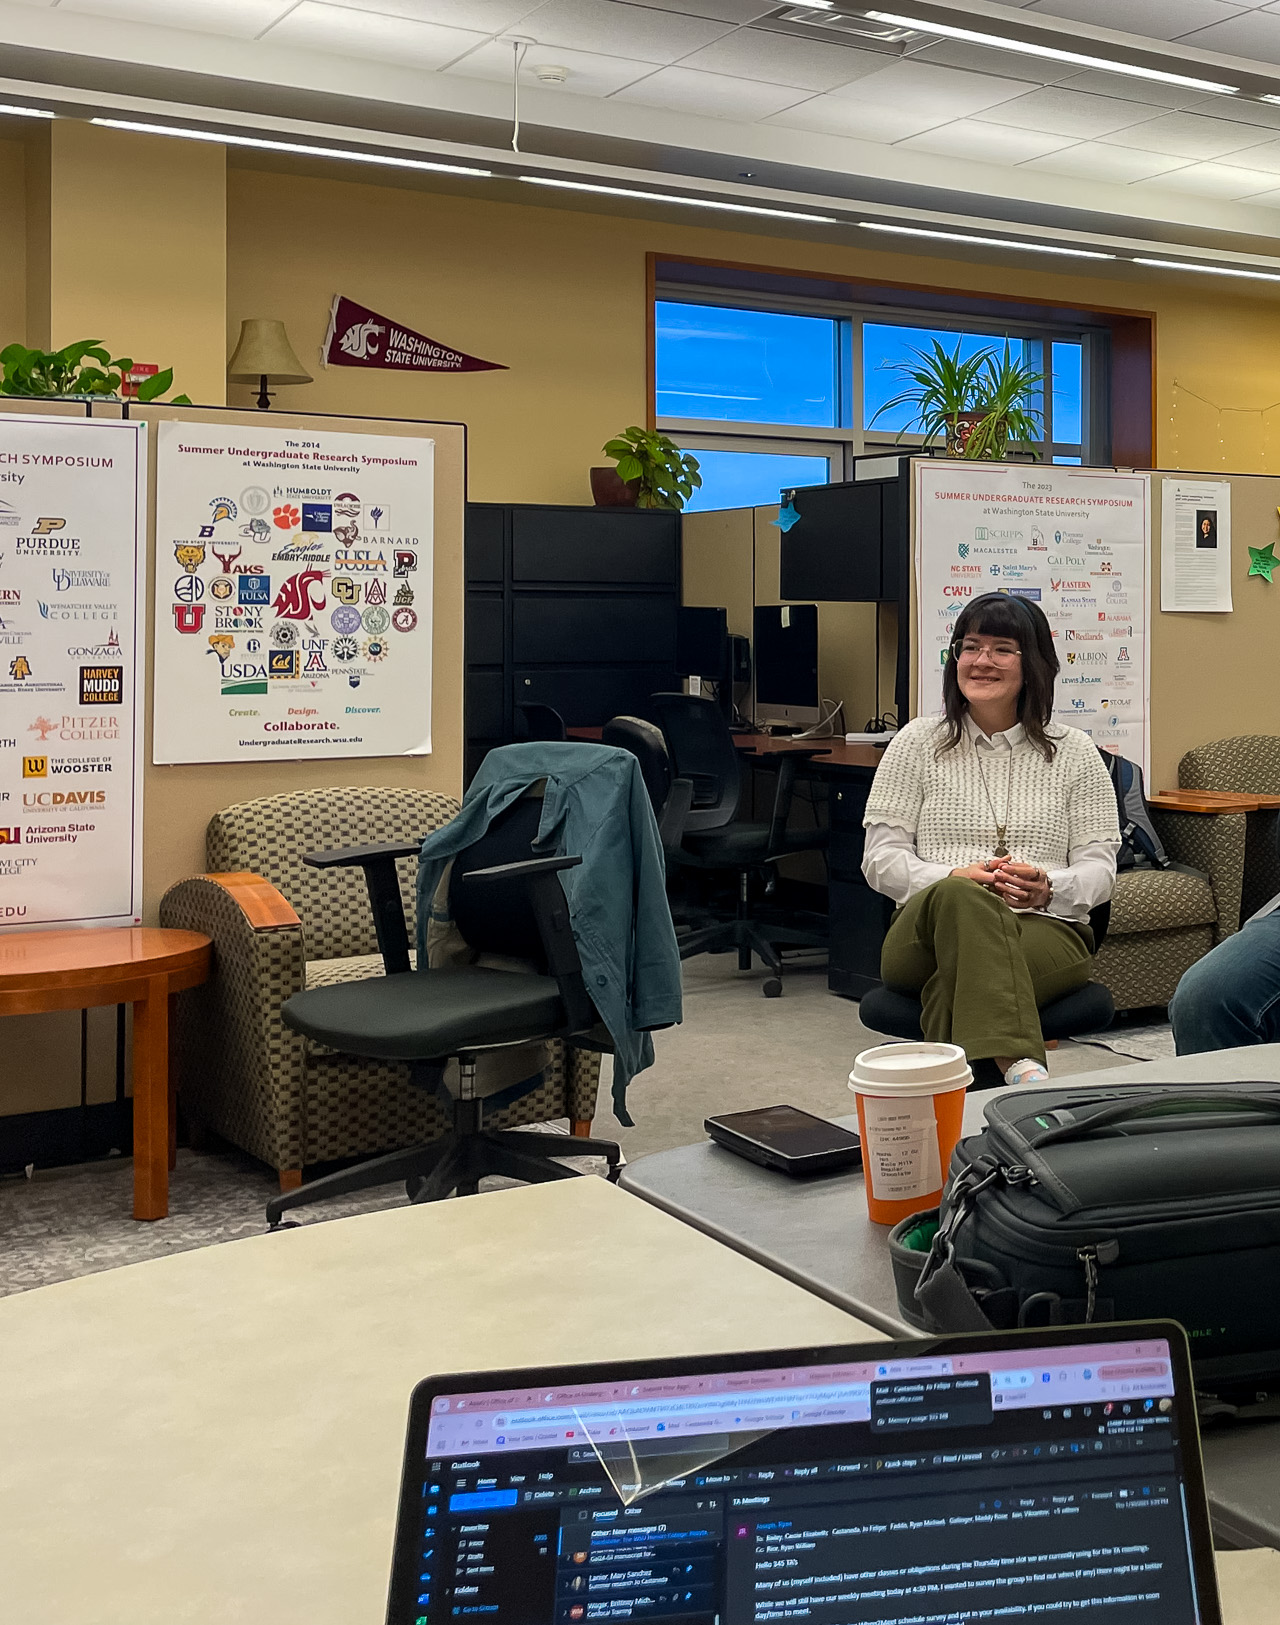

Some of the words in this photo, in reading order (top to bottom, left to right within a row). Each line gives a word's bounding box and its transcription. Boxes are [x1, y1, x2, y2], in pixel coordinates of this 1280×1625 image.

[389, 327, 463, 363] WASHINGTON
[384, 348, 411, 365] STATE
[412, 356, 462, 369] UNIVERSITY
[301, 441, 320, 449] 2014
[22, 454, 113, 468] SYMPOSIUM
[178, 444, 224, 455] Summer
[227, 447, 309, 460] Undergraduate
[312, 452, 358, 463] Research
[361, 455, 418, 467] Symposium
[253, 461, 299, 470] Washington
[301, 463, 321, 471] State
[323, 464, 360, 474] University
[286, 487, 332, 496] HUMBOLDT
[1022, 481, 1036, 489] The
[1037, 484, 1053, 492] 2023
[935, 491, 971, 500] SUMMER
[972, 494, 1044, 504] UNDERGRADUATE
[1045, 497, 1086, 506] RESEARCH
[1087, 499, 1133, 507] SYMPOSIUM
[992, 507, 1034, 517] Washington
[1035, 509, 1054, 517] State
[1055, 510, 1090, 519] University
[16, 537, 80, 549] PURDUE
[362, 536, 419, 545] BARNARD
[271, 552, 331, 563] EMBRY-RIDDLE
[334, 549, 389, 572] SUSLA
[1062, 581, 1091, 589] EASTERN
[240, 592, 269, 601] TULSA
[943, 586, 972, 596] CWU
[50, 611, 118, 620] COLLEGE
[215, 606, 264, 617] STONY
[302, 639, 330, 650] UNF
[67, 646, 122, 656] GONZAGA
[83, 667, 119, 678] HARVEY
[221, 663, 268, 678] USDA
[83, 679, 119, 692] MUDD
[83, 692, 119, 702] COLLEGE
[228, 708, 261, 717] Create.
[287, 707, 319, 717] Design.
[344, 706, 381, 714] Discover.
[61, 716, 119, 728] PITZER
[263, 720, 340, 732] Collaborate.
[59, 729, 120, 741] COLLEGE
[51, 764, 113, 774] WOOSTER
[26, 825, 66, 834] Arizona
[67, 823, 96, 832] State
[25, 834, 78, 844] University
[451, 1460, 481, 1471] Outlook
[757, 1471, 775, 1480] Reply
[476, 1478, 498, 1486] Home
[742, 1496, 771, 1505] Meetings
[592, 1508, 619, 1518] Focused
[755, 1561, 772, 1570] Hello
[755, 1581, 774, 1590] Many
[774, 1580, 782, 1588] of
[790, 1577, 814, 1588] (myself
[814, 1573, 843, 1584] included)
[843, 1572, 859, 1581] have
[859, 1570, 877, 1580] other
[877, 1568, 899, 1578] classes
[940, 1561, 961, 1571] during
[961, 1560, 973, 1569] the
[973, 1557, 1001, 1569] Thursday
[1000, 1556, 1015, 1566] time
[1015, 1555, 1027, 1564] slot
[1027, 1555, 1038, 1563] we
